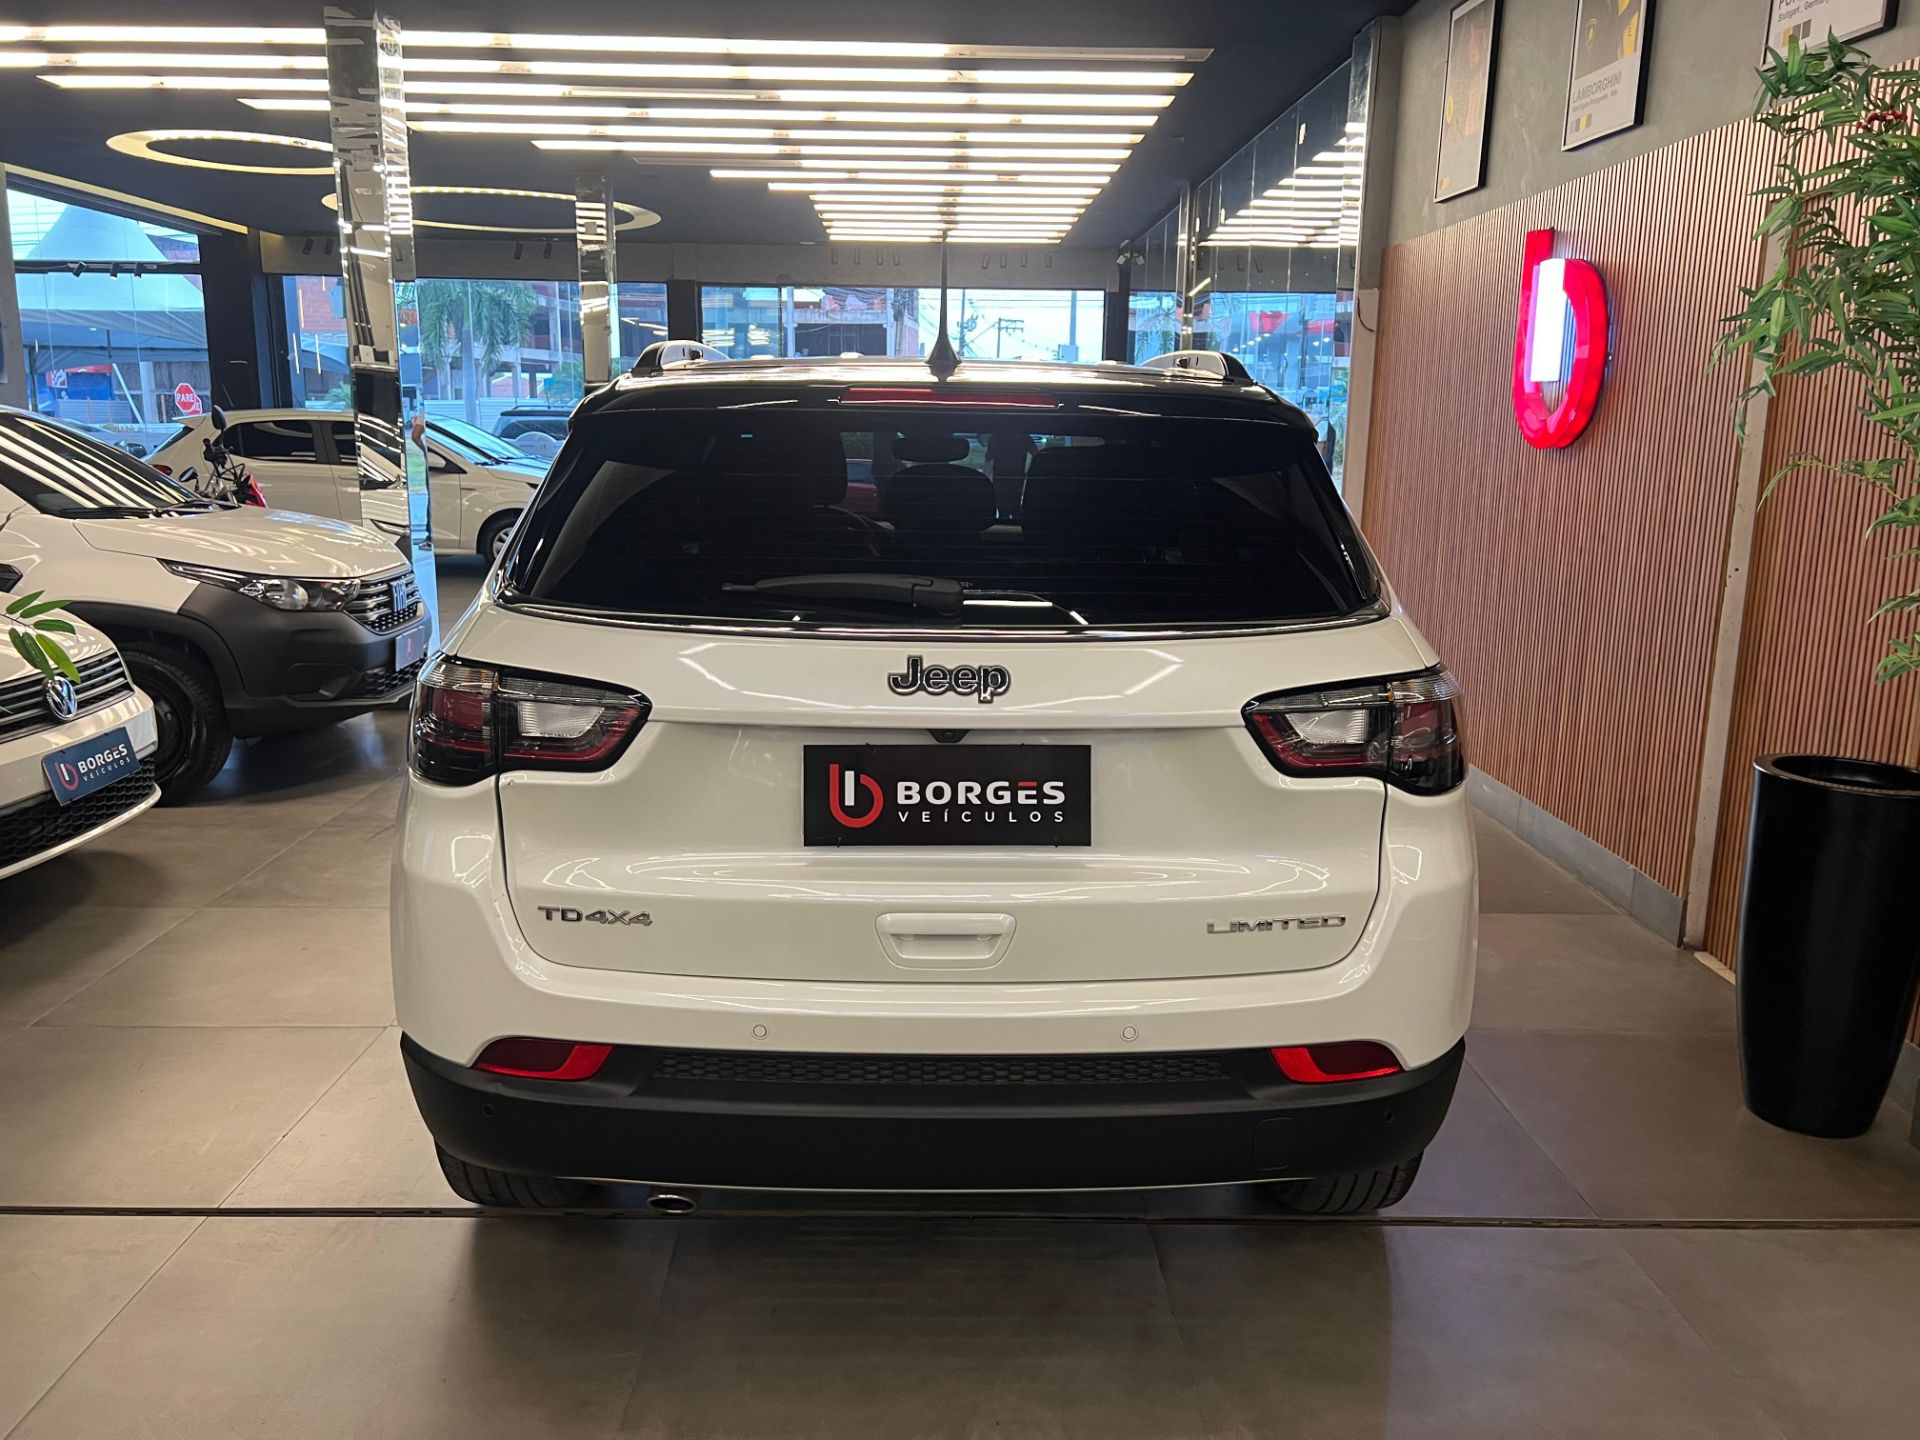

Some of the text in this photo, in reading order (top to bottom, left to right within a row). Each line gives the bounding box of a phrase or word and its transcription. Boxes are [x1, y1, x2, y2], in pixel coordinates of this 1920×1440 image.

[1573, 71, 1622, 104] LAMBORGHINI
[176, 393, 194, 402] PARE
[889, 655, 1010, 703] Jeep
[78, 744, 128, 773] BORGES
[83, 757, 130, 781] VEÍCULOS
[897, 781, 1065, 804] BORGES
[898, 809, 1064, 822] VEÍCULOS
[1207, 914, 1346, 934] LIMITED
